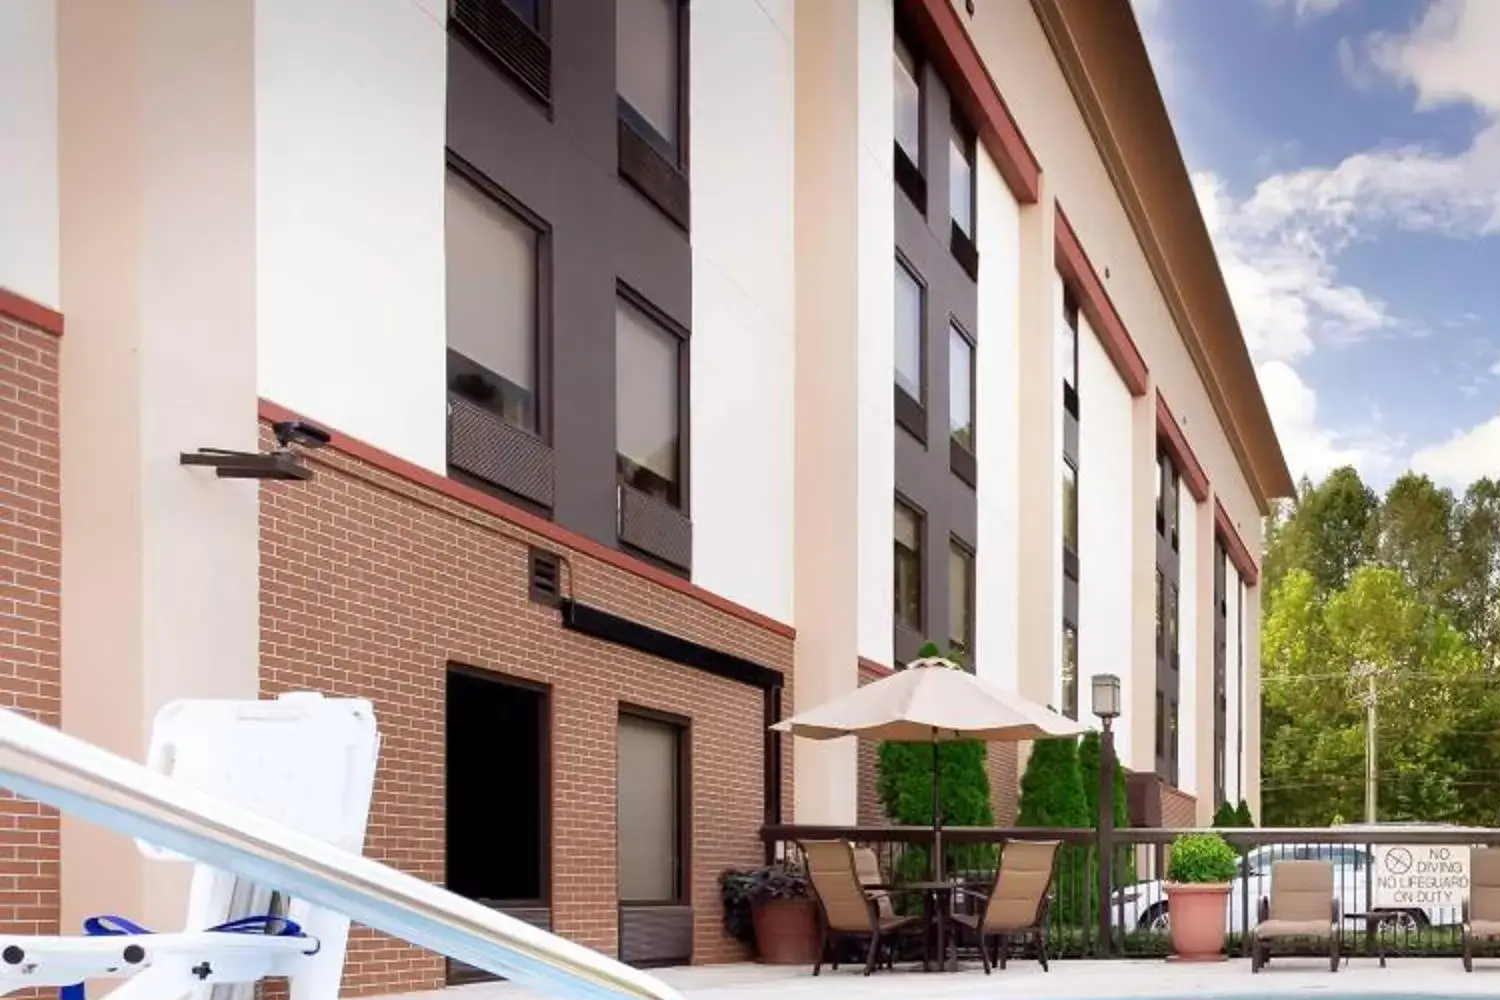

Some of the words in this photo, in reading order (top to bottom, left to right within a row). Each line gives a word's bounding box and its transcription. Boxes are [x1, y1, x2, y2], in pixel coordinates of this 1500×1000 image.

[1429, 847, 1450, 861] NO
[1417, 861, 1463, 873] DIVING
[1377, 876, 1397, 889] NO
[1399, 875, 1468, 889] LIFEGUARD
[1394, 891, 1413, 903] ON
[1416, 890, 1452, 903] DUTY
